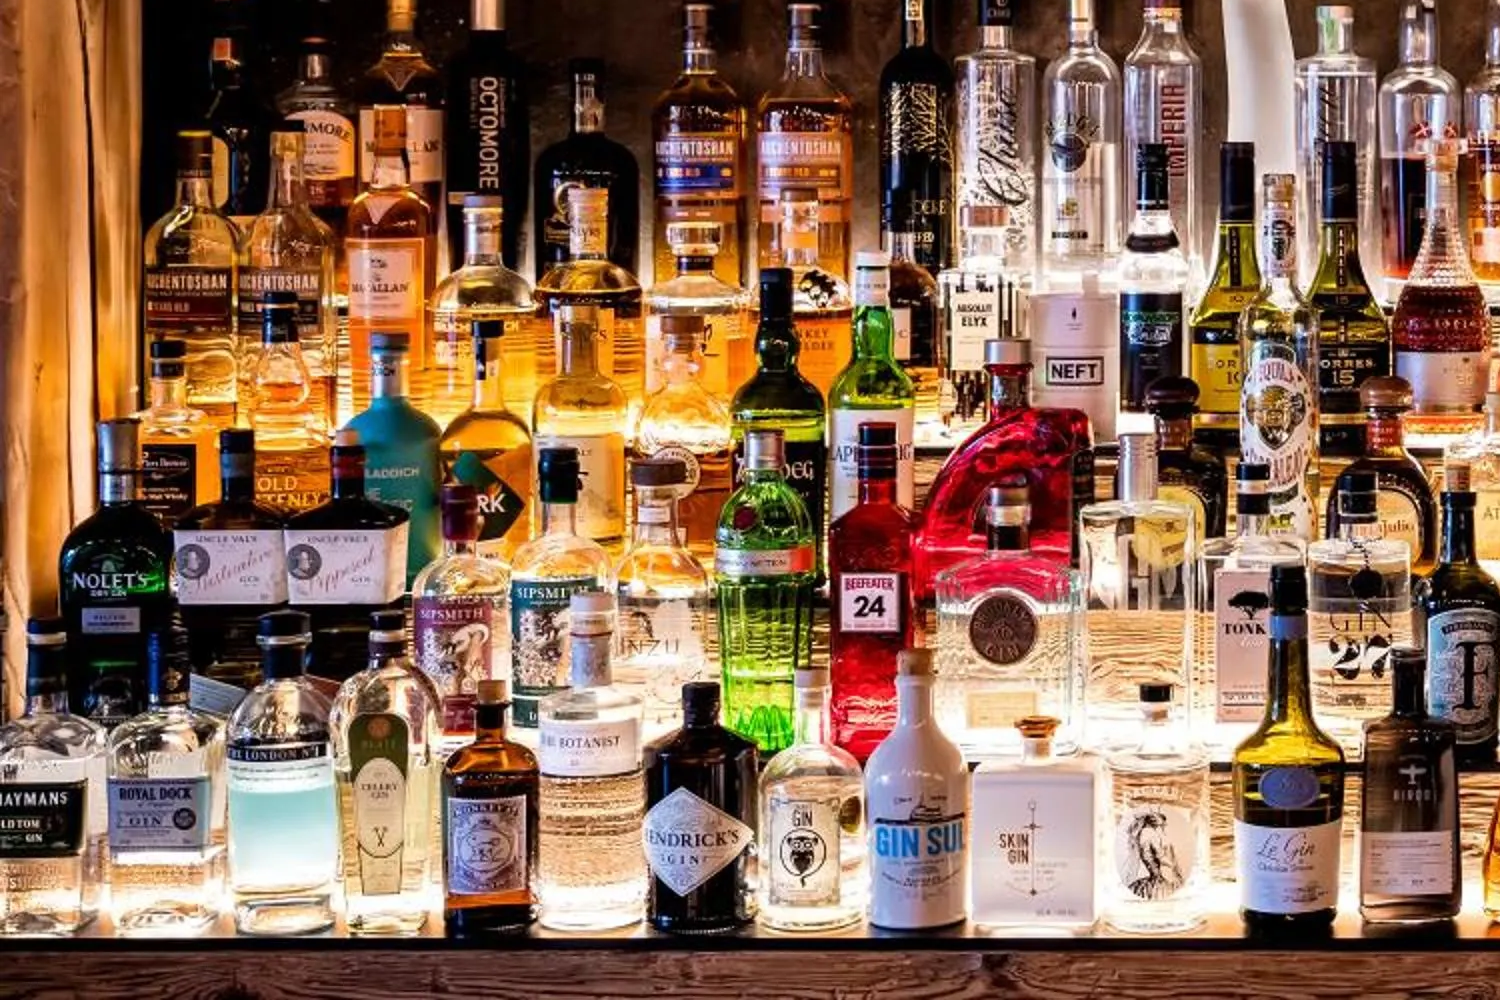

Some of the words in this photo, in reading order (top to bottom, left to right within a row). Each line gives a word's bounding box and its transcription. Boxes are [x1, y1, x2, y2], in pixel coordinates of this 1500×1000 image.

[306, 122, 351, 141] MORE
[479, 77, 499, 189] OCTOMORE
[961, 316, 988, 328] ELYX
[1051, 361, 1099, 380] NEFT
[1320, 359, 1374, 369] ORRES
[1332, 370, 1355, 385] 15
[258, 476, 297, 492] OLD
[256, 492, 321, 507] TENEY
[73, 571, 148, 589] NOLET'S
[844, 577, 894, 591] BEEFEATER
[420, 608, 484, 620] SIPSMITH
[853, 596, 886, 619] 24
[1221, 623, 1267, 636] TONK
[1451, 641, 1497, 710] F
[559, 735, 621, 749] BOTANIST
[245, 749, 297, 761] LONDON
[119, 787, 157, 800] ROYAL
[159, 787, 193, 801] DOCK
[129, 816, 163, 826] GIN
[792, 809, 814, 827] GIN
[875, 826, 920, 858] GIN
[1000, 833, 1029, 849] SKIN
[1007, 850, 1029, 865] GIN
